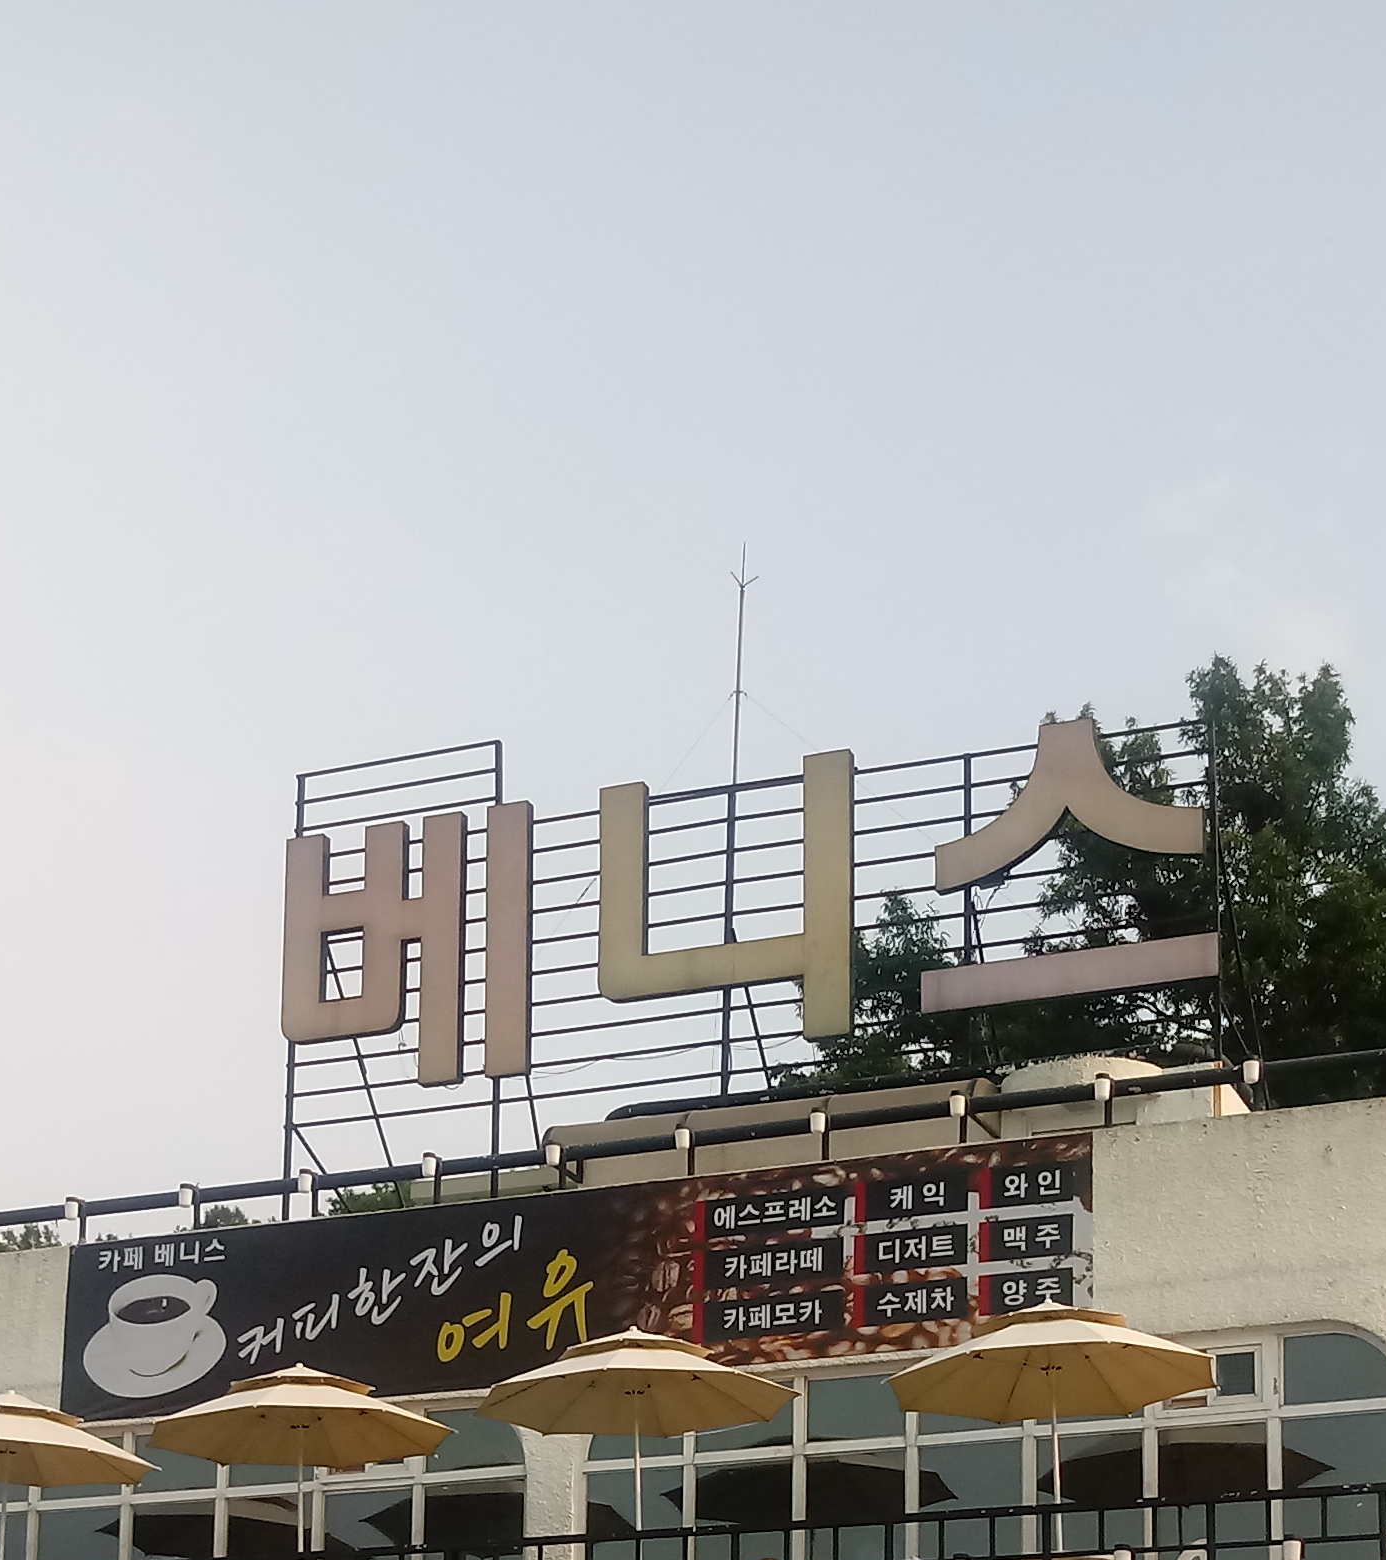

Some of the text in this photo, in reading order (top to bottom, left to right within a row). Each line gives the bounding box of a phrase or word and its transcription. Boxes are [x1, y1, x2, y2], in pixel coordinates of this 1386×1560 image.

[282, 718, 1219, 1086] 베니스
[1003, 1169, 1063, 1199] 와인
[713, 1193, 839, 1231] 에스프레소
[878, 1232, 956, 1264] 디저트
[1002, 1221, 1062, 1252] 맥주
[97, 1237, 227, 1274] 카페 베니스
[723, 1246, 824, 1280] 카페라떼
[436, 1248, 595, 1364] 여유
[722, 1298, 823, 1332] 카페모카
[876, 1285, 955, 1319] 수제차
